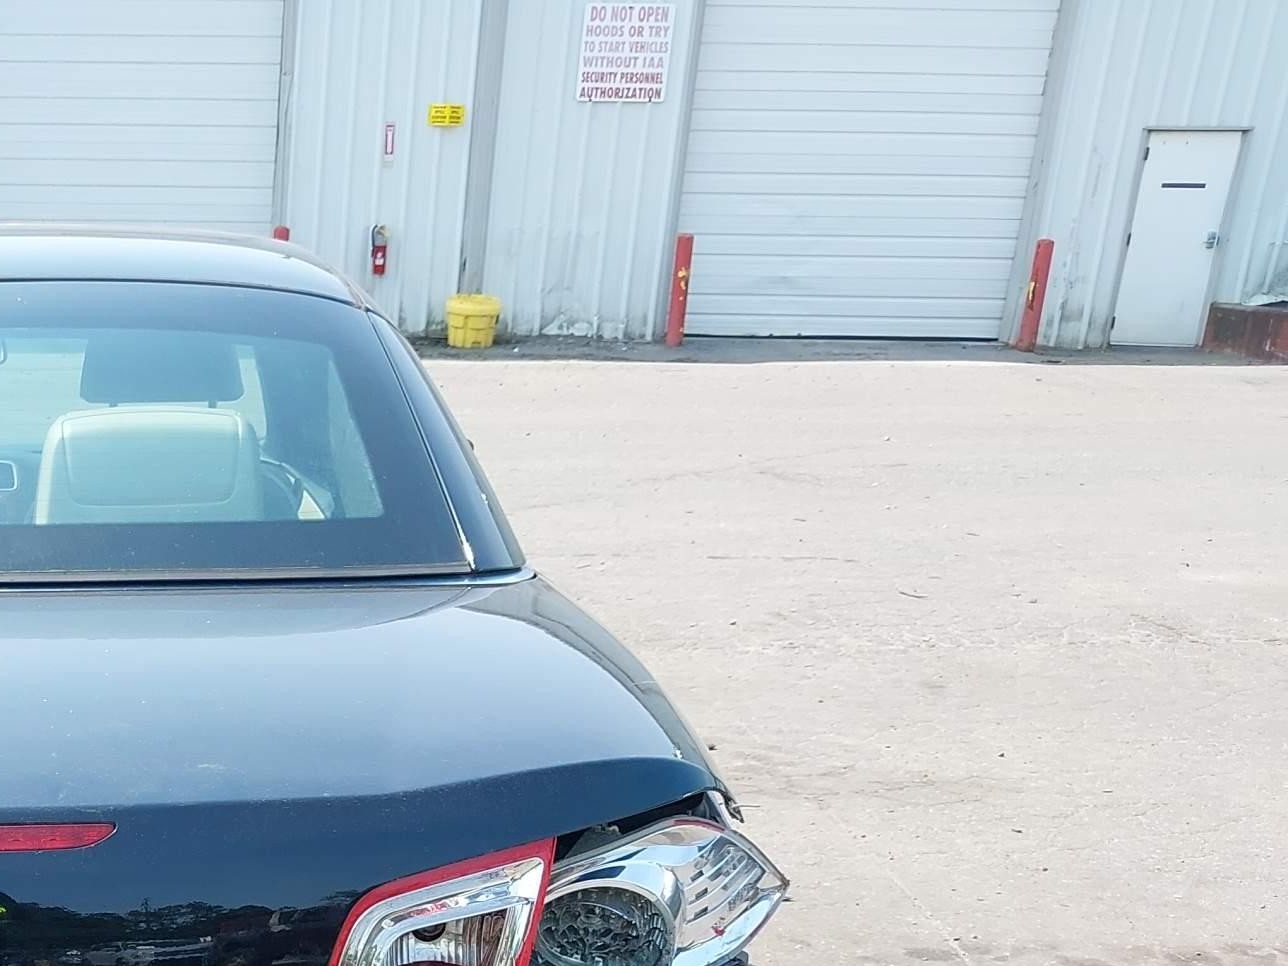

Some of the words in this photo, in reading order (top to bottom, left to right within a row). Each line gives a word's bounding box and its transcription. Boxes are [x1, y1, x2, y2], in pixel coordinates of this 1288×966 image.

[590, 6, 607, 22] DO
[611, 6, 634, 22] NOT
[638, 6, 670, 22] OPEN
[585, 25, 625, 37] HOODS
[628, 25, 645, 37] OR
[648, 25, 670, 38] TRY
[583, 41, 595, 53] TO
[598, 41, 626, 53] START
[628, 41, 669, 53] VEHICLES
[583, 56, 639, 68] WITHOUT
[642, 56, 664, 68] IAA
[581, 72, 618, 84] SECURITY
[619, 72, 663, 84] PERSONNEL
[579, 87, 662, 100] AUTHORIZATION
